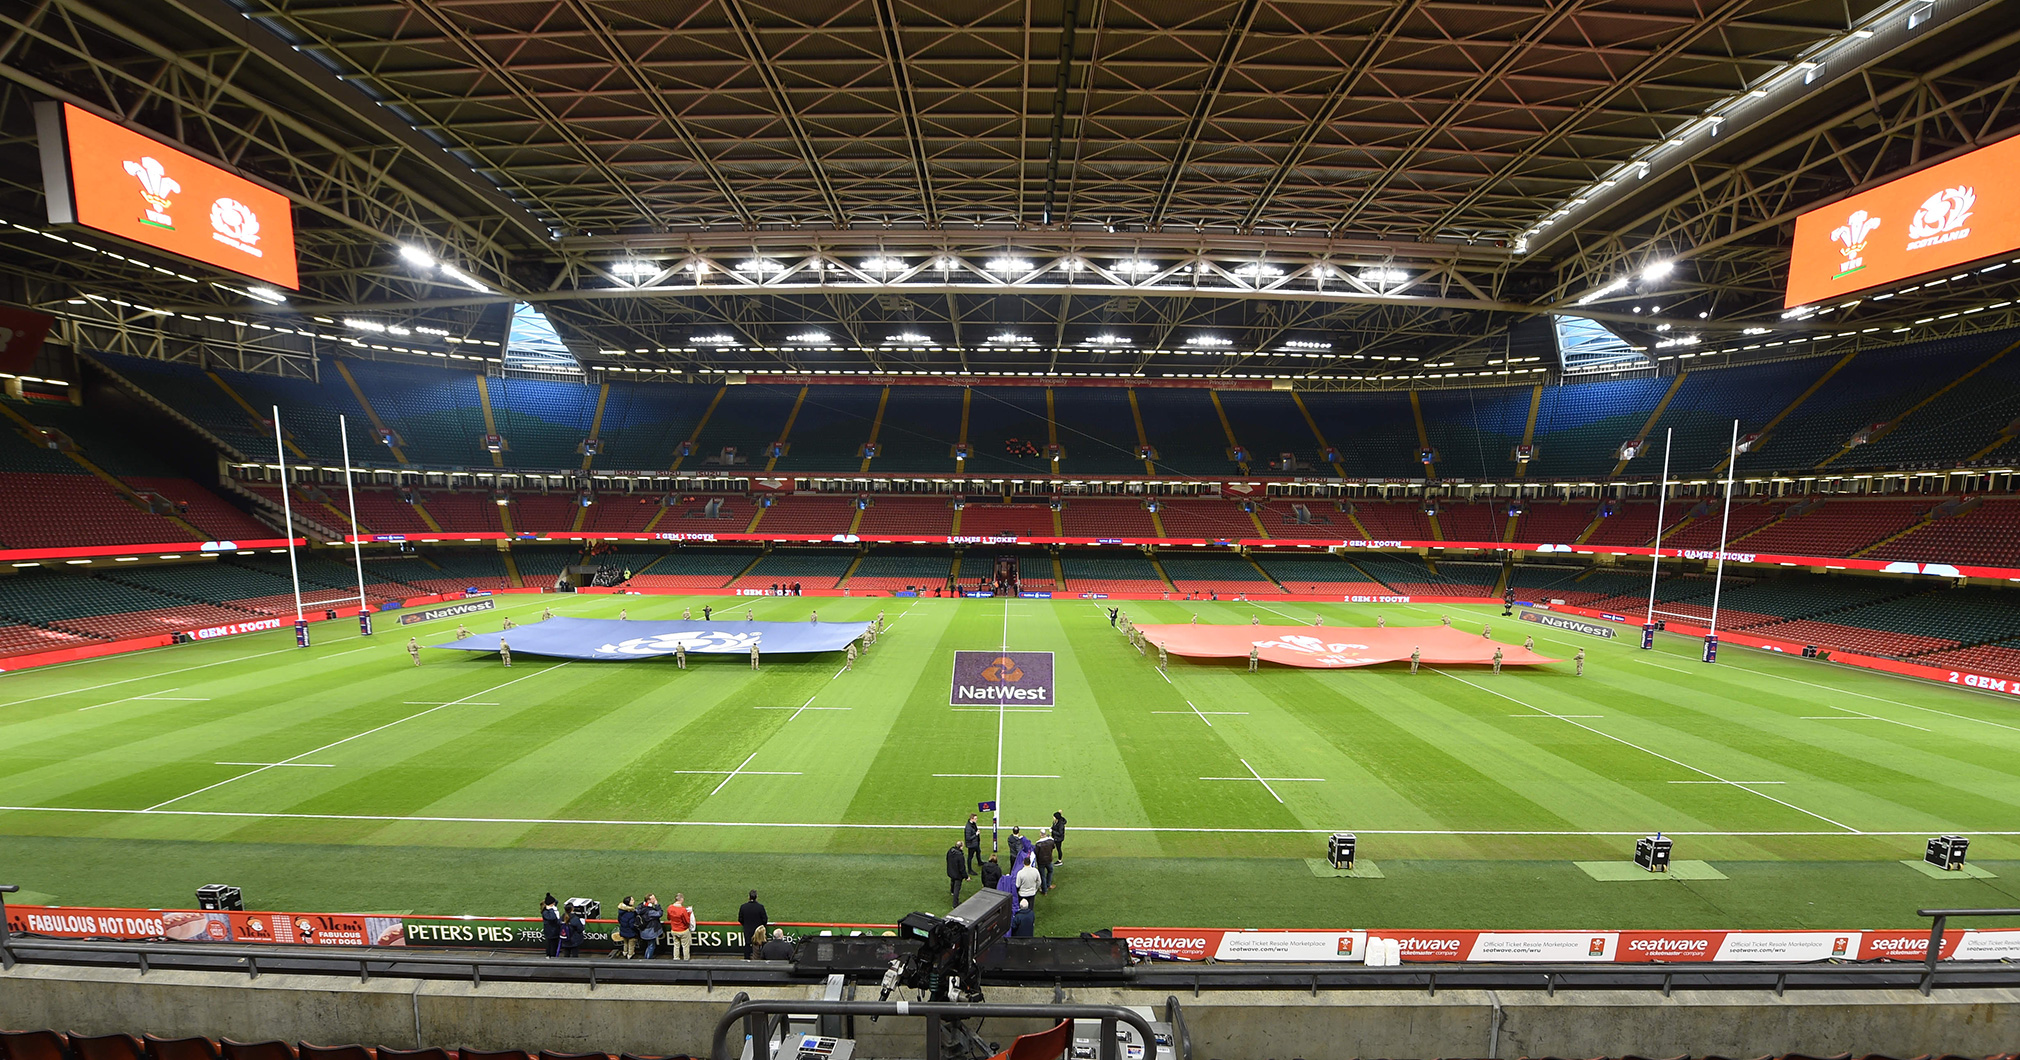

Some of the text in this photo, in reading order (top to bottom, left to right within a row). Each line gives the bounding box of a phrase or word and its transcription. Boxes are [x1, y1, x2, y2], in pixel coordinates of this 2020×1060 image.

[1684, 550, 1713, 559] GAMES
[1722, 552, 1756, 562] TICKET
[425, 601, 492, 620] NatWest
[198, 626, 228, 639] GEM
[229, 625, 237, 634] 1
[239, 618, 280, 632] TOCYN
[1541, 616, 1609, 637] NatWest
[1948, 671, 2020, 695] 2 GEM 1
[958, 685, 1047, 700] NatWest
[27, 914, 97, 933] FABULOUS
[98, 916, 125, 934] HOT
[125, 917, 164, 936] DOGS
[316, 916, 362, 931] Mom's
[407, 924, 514, 942] PETER'S PIES
[522, 931, 543, 939] FEED
[583, 932, 608, 941] SSION!
[1126, 935, 1206, 949] seatwave
[1399, 937, 1460, 950] atwave
[1543, 941, 1578, 949] Marketplace
[1628, 937, 1708, 951] seatwave
[1870, 936, 1947, 950] seatwae
